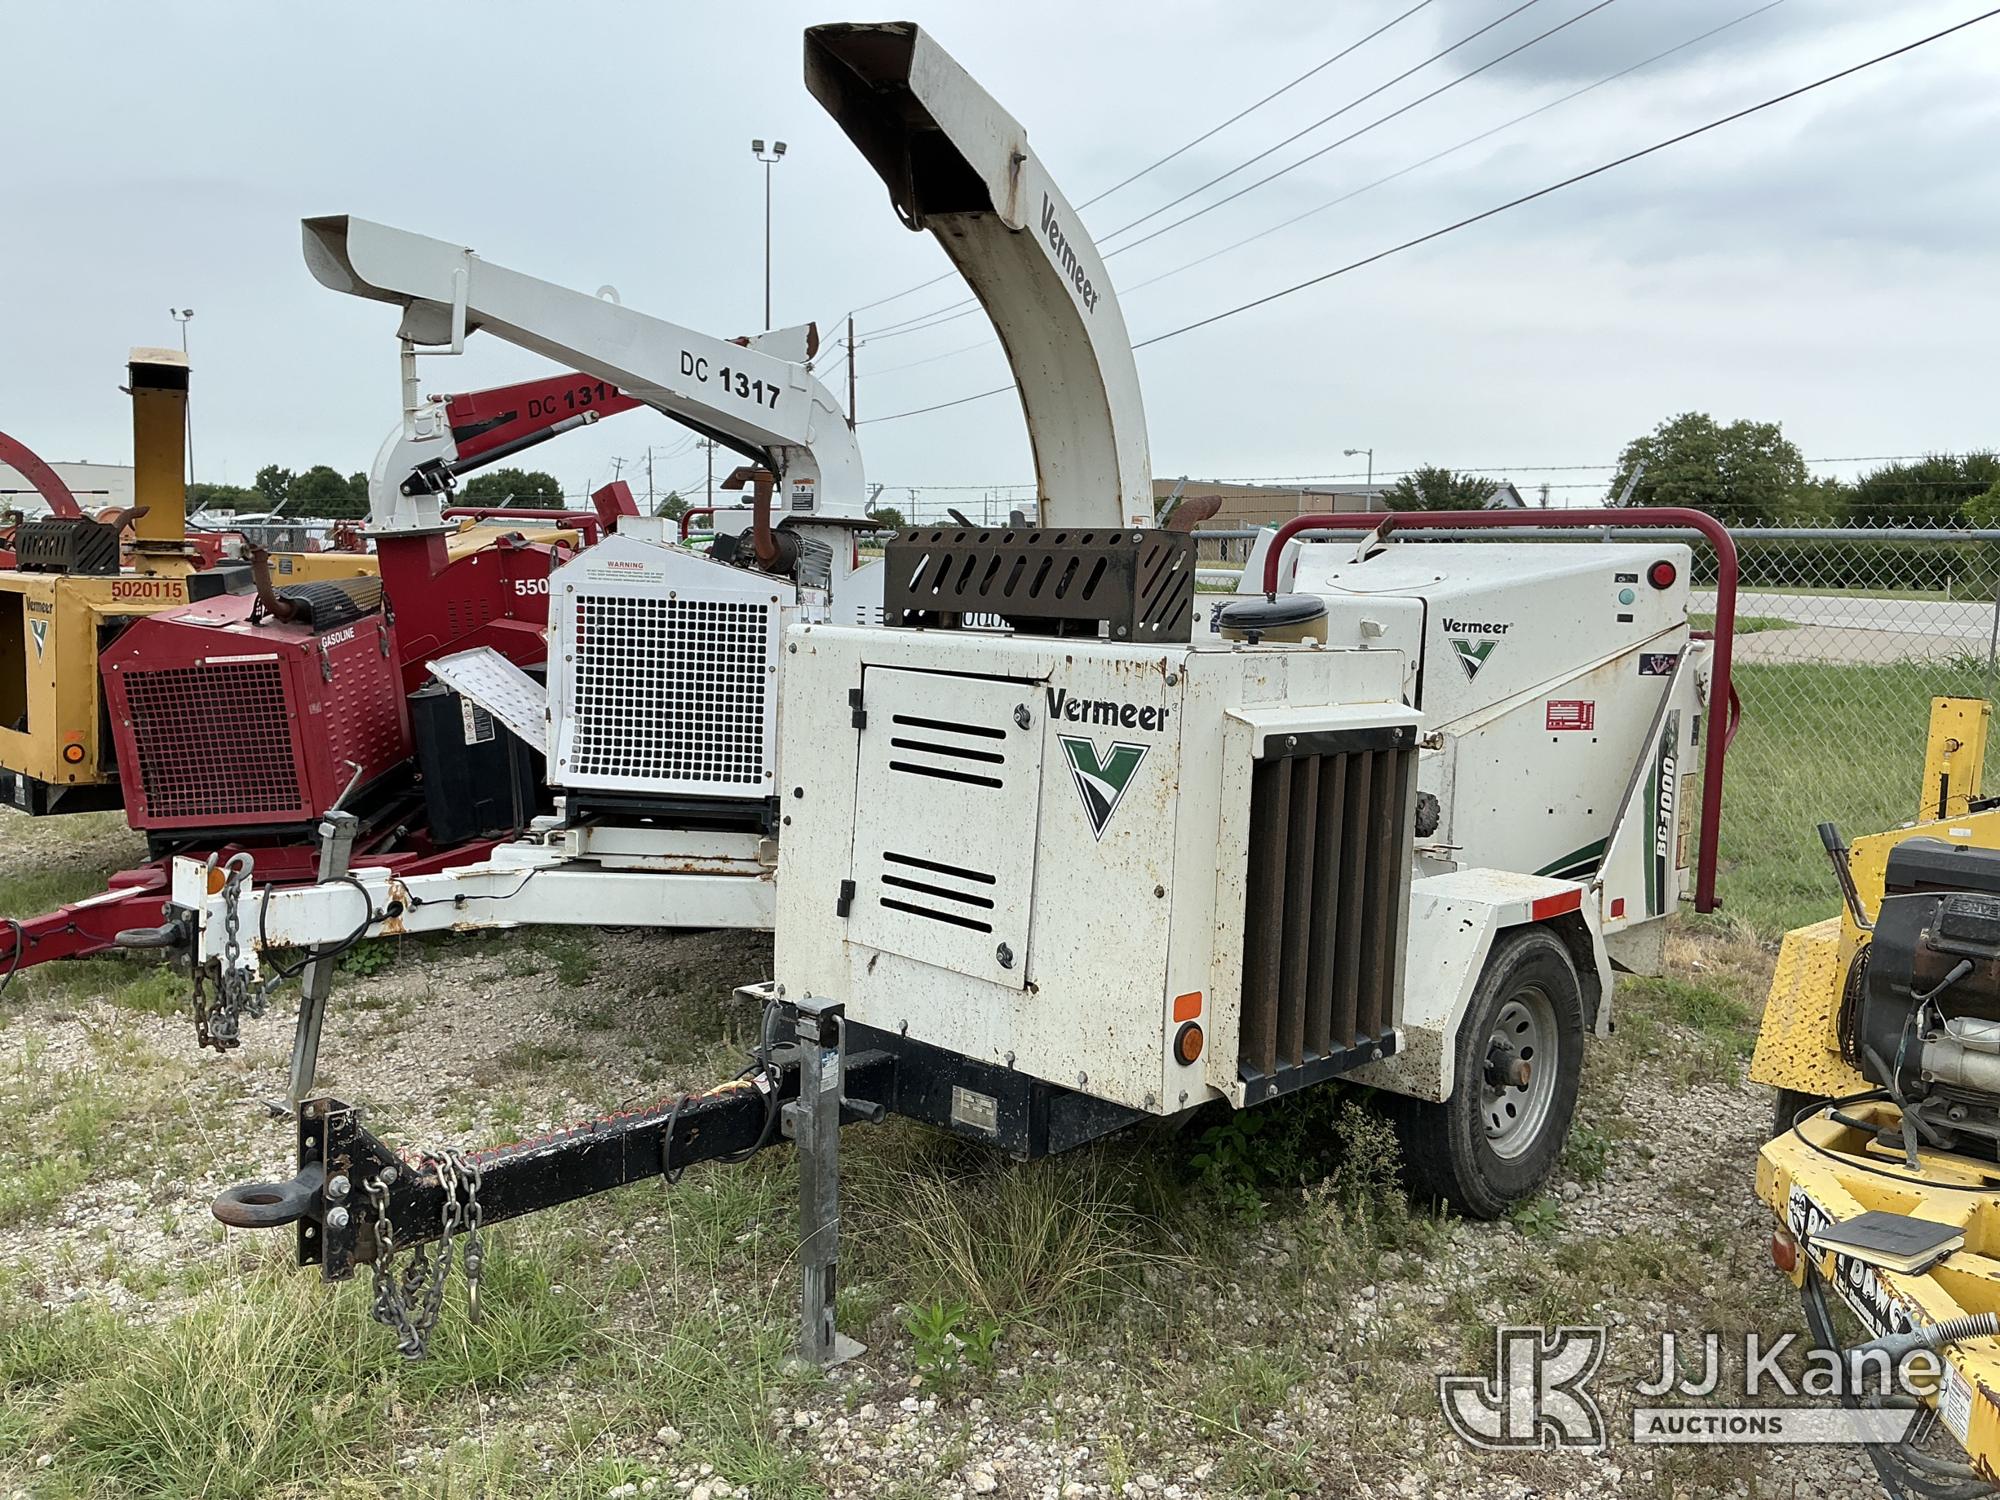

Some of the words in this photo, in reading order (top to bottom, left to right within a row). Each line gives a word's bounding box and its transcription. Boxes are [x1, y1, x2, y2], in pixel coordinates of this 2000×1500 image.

[1041, 190, 1098, 315] Vermeer
[681, 350, 708, 383] DC
[719, 366, 781, 409] 1317
[528, 395, 557, 418] DC
[607, 561, 644, 569] WARNING
[111, 581, 182, 598] 5020115
[25, 595, 53, 614] Vermeer
[1442, 617, 1509, 634] Vermeer
[321, 626, 355, 648] GASOLINE
[1047, 686, 1170, 732] Vermeer
[1656, 756, 1675, 857] BC1000
